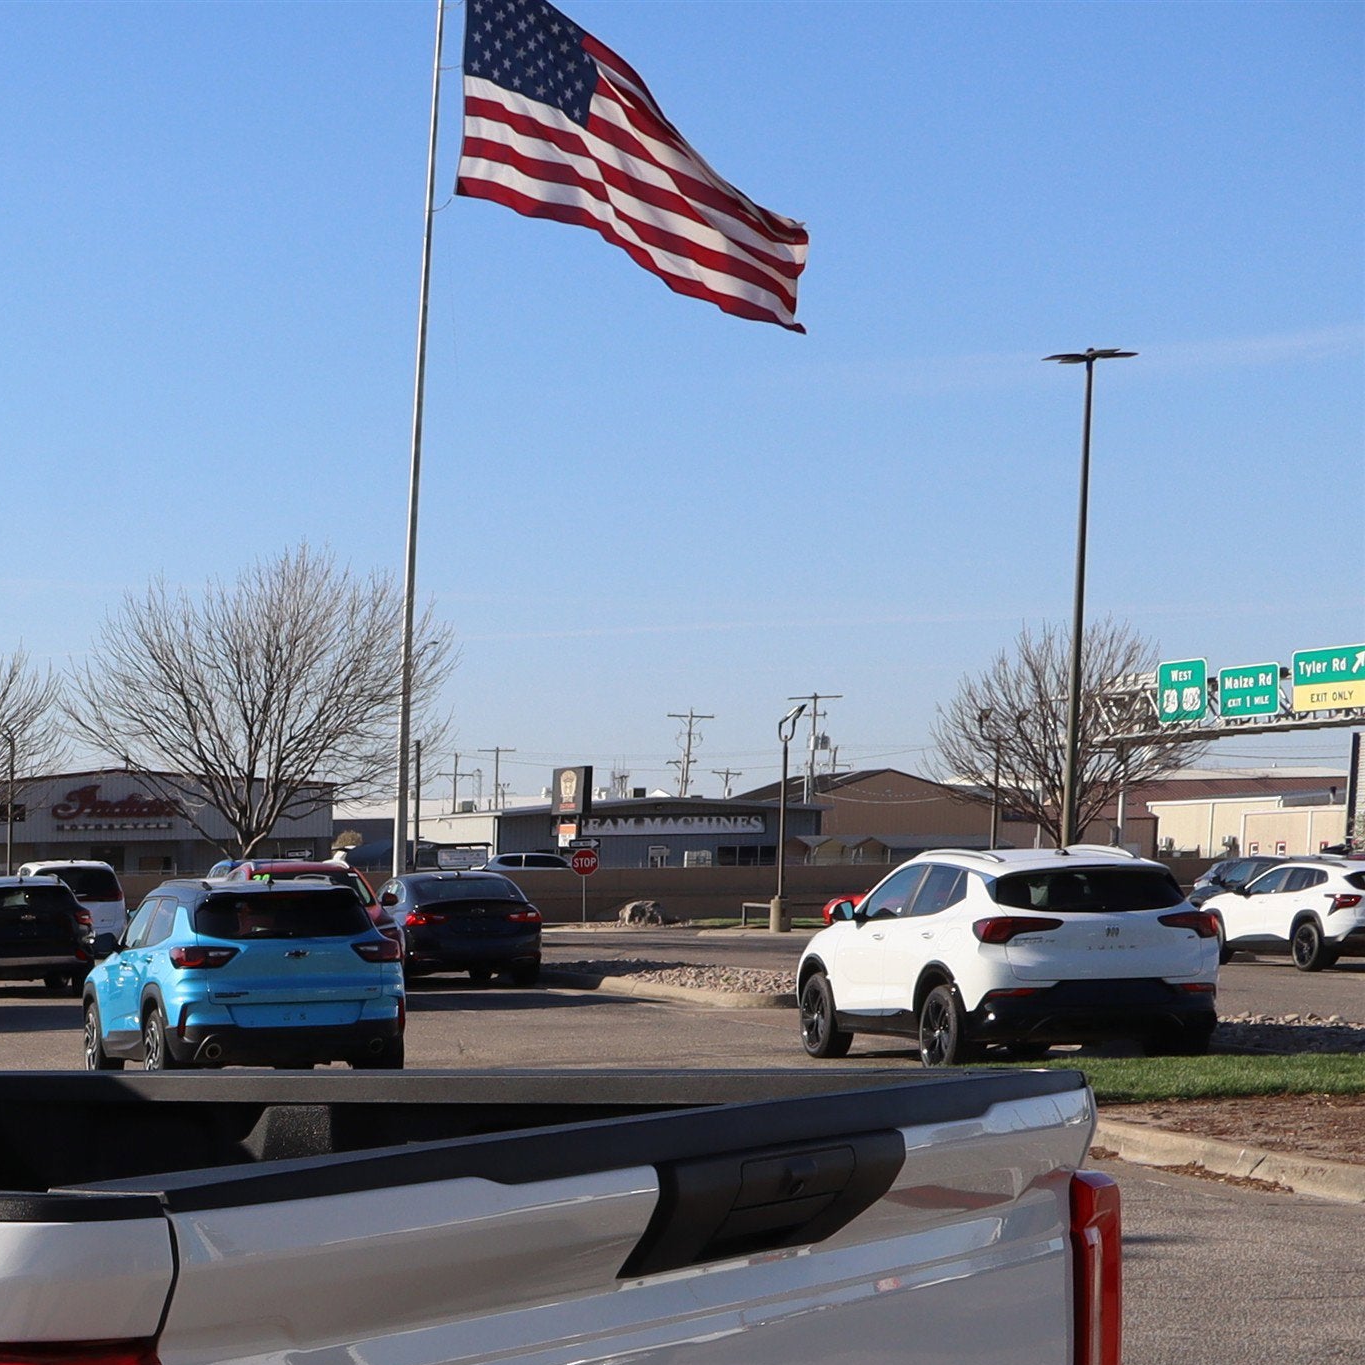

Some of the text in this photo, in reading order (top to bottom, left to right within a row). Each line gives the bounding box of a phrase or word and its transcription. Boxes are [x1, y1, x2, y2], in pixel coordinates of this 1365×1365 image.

[1298, 657, 1347, 677] Tyler Rd
[1171, 669, 1192, 682] WEST
[1224, 672, 1272, 690] Maize Rd
[1227, 694, 1270, 708] EXIT 1 MILE
[1310, 690, 1354, 703] EXIT ONLY
[56, 821, 174, 832] MOTORCYCLE
[643, 815, 764, 832] MACHINES
[572, 856, 597, 869] STOP
